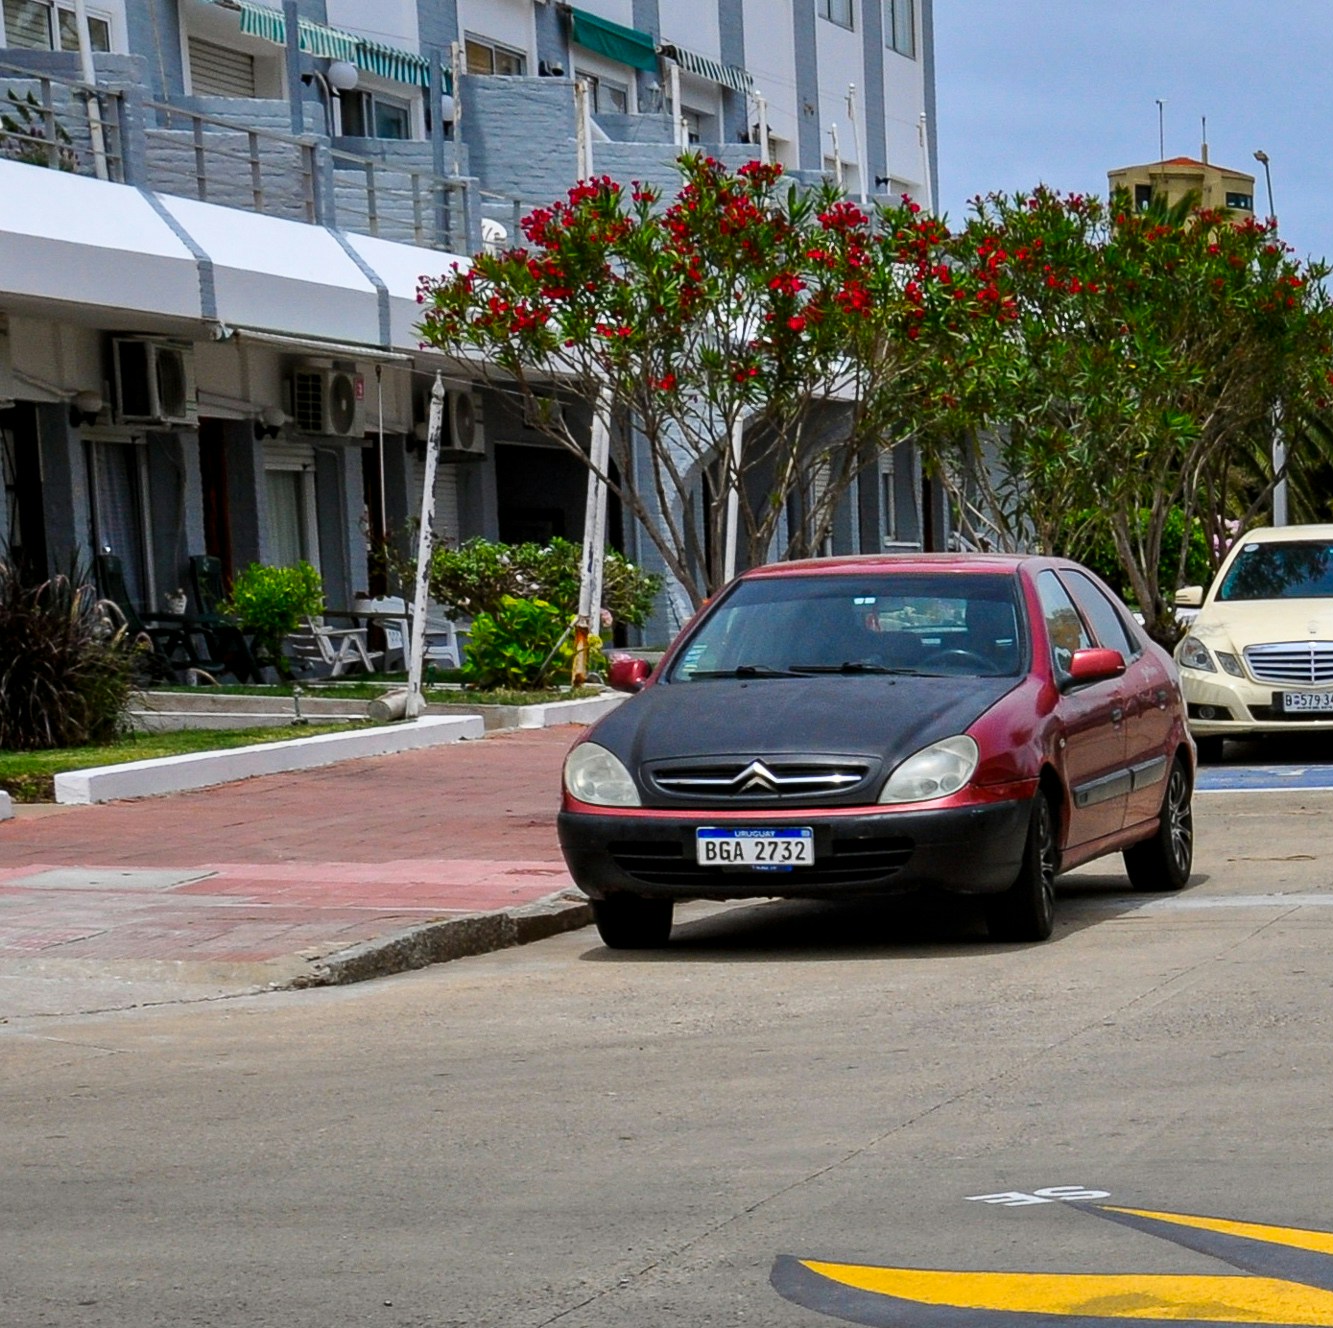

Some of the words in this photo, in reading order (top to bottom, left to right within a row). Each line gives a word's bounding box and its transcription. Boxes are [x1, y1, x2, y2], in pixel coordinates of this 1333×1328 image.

[734, 830, 776, 838] URUGUAY
[705, 841, 744, 861] BGA
[754, 841, 806, 861] 2732
